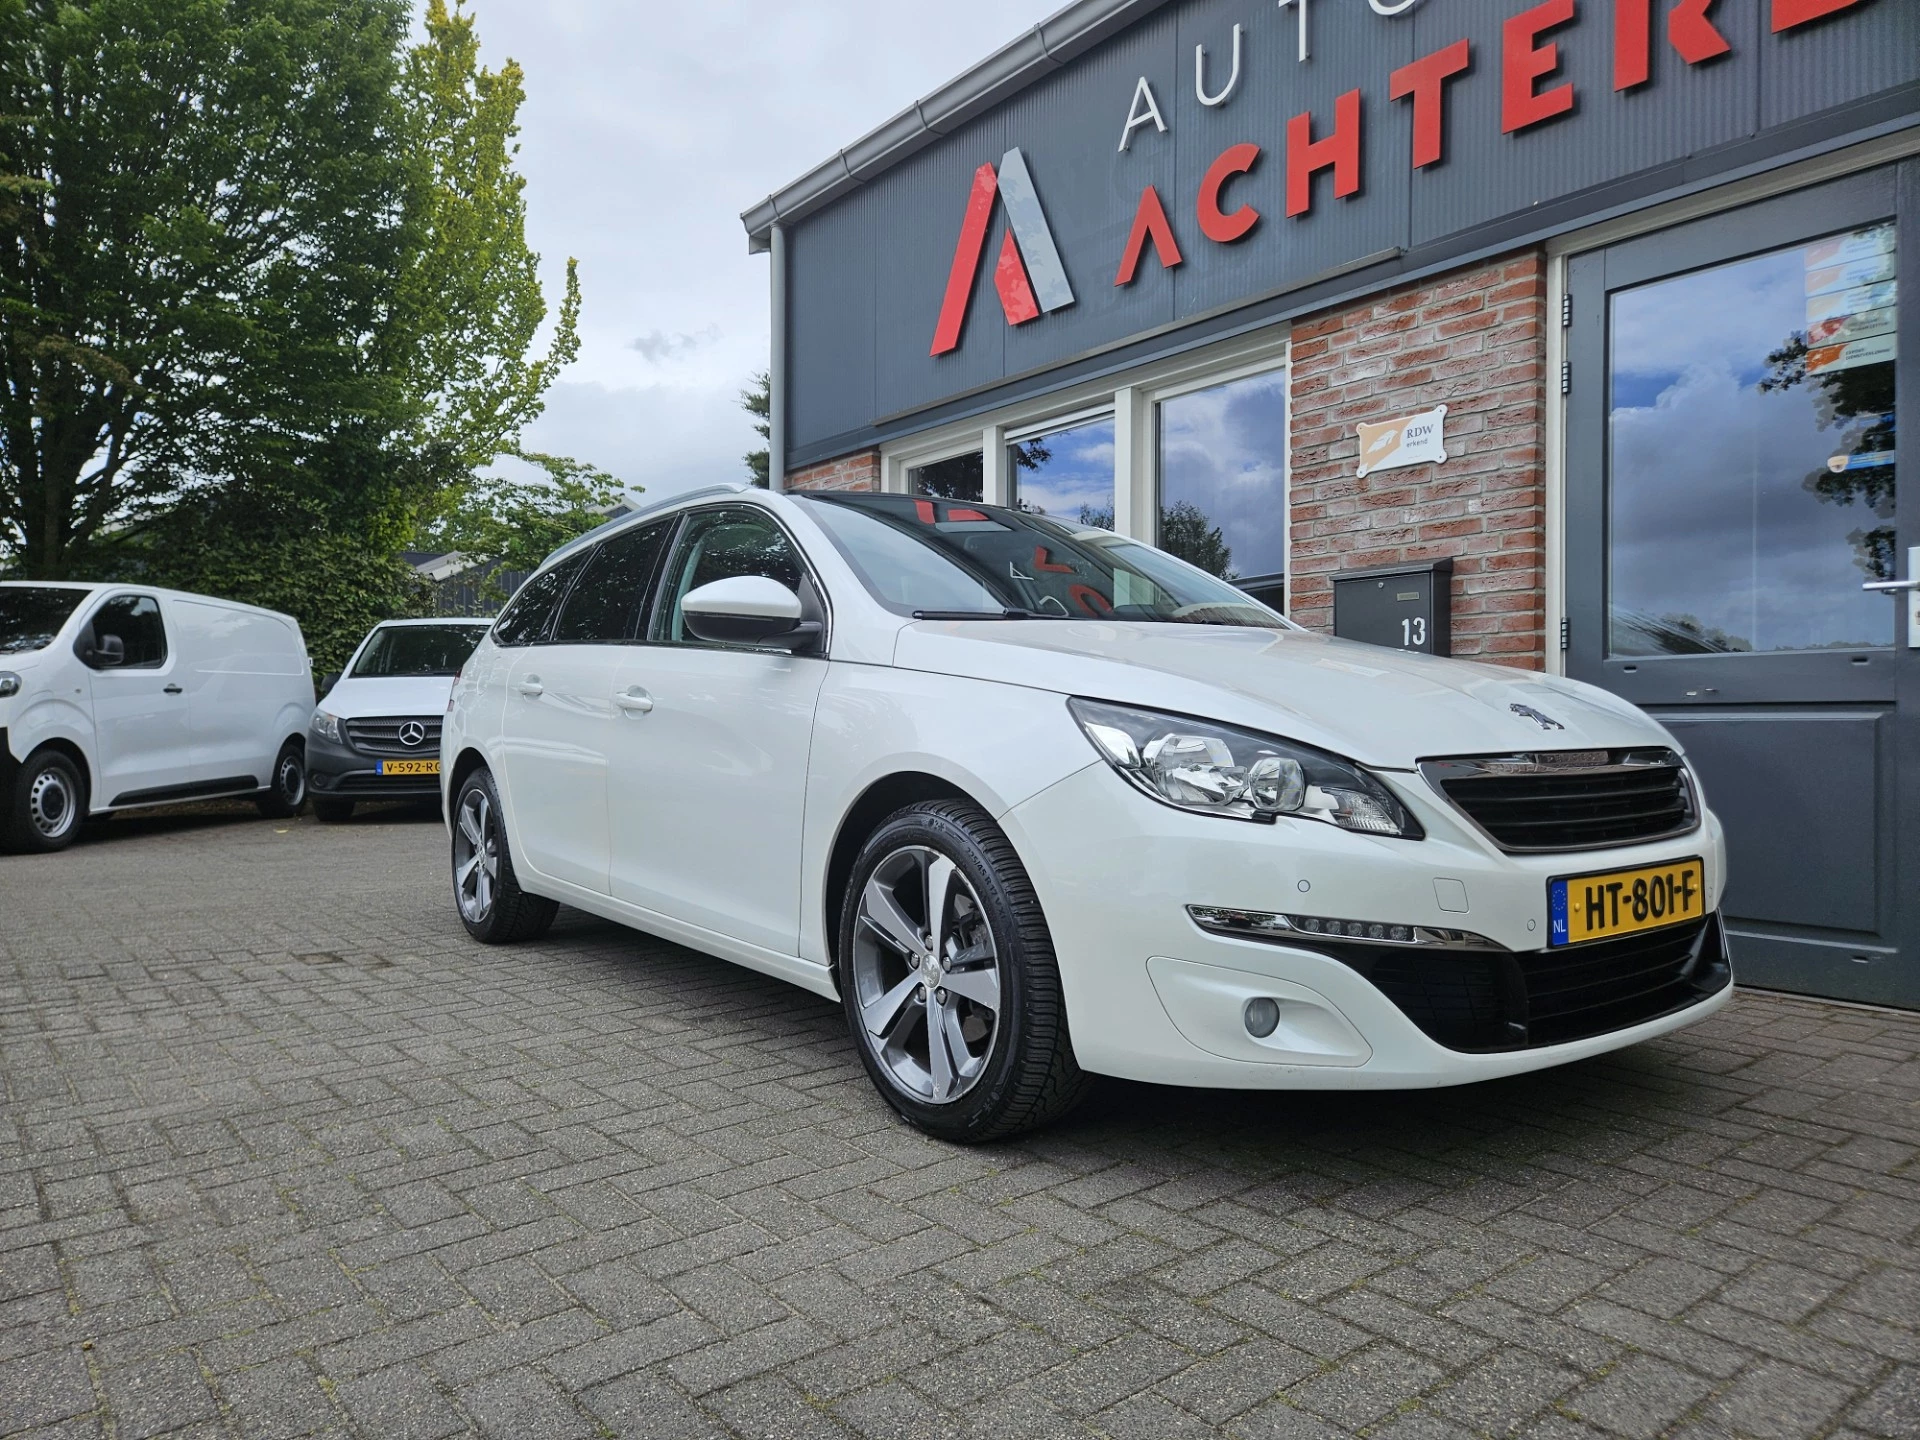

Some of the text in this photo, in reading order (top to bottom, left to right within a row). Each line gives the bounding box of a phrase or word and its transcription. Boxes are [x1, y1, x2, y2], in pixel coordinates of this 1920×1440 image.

[1118, 0, 1416, 152] AUT
[1406, 424, 1434, 439] RDW
[1406, 437, 1429, 448] erkend
[1401, 617, 1426, 646] 13
[1585, 869, 1697, 931] HT-801-F
[1553, 919, 1567, 934] NL
